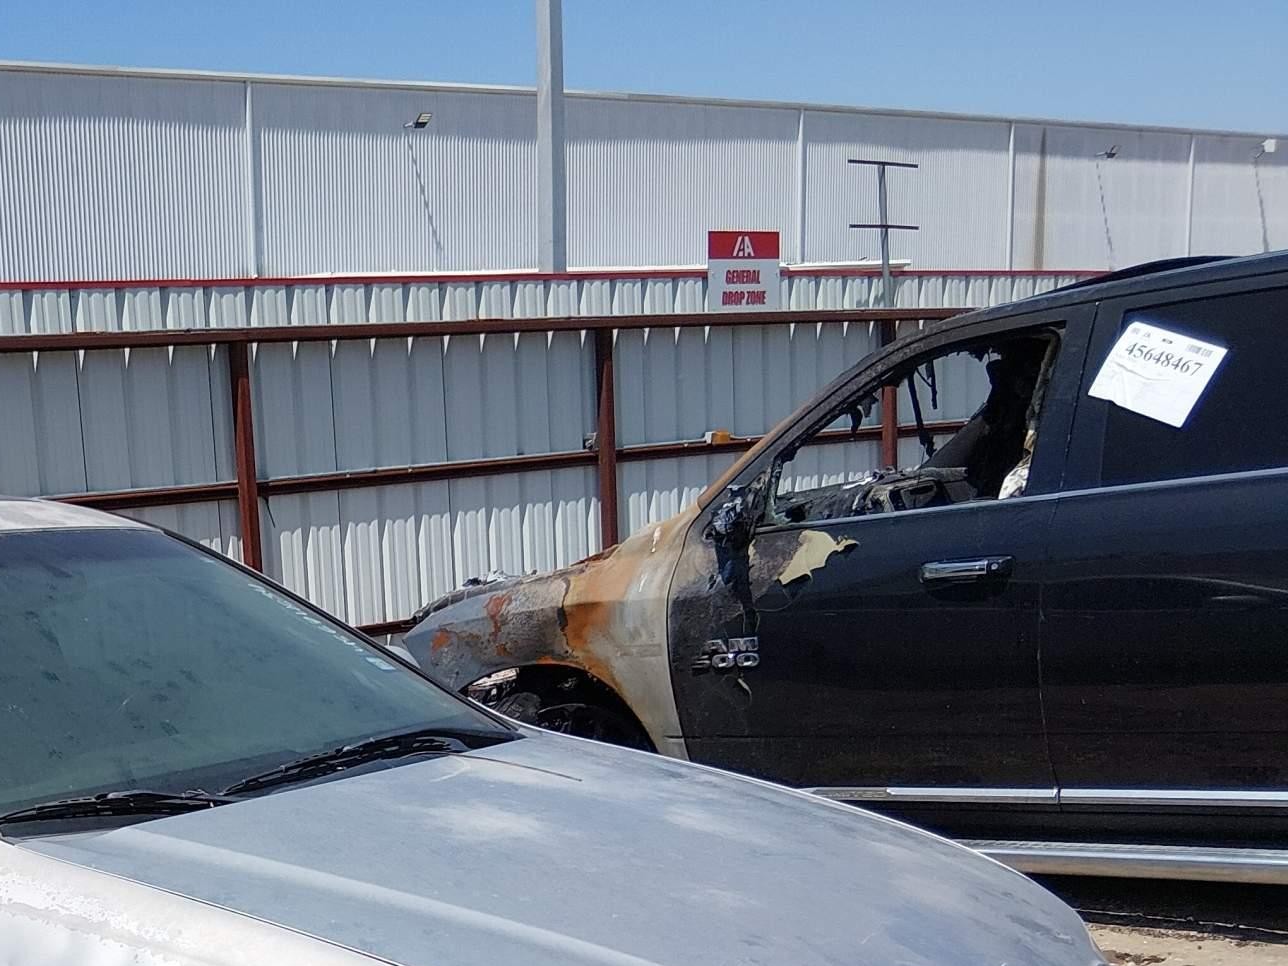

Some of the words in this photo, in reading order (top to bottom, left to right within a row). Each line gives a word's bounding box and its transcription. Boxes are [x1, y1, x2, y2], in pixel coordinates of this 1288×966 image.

[725, 269, 760, 284] GENERAL
[722, 291, 745, 306] DROP
[746, 290, 766, 305] ZONE
[1126, 342, 1203, 376] 45648467
